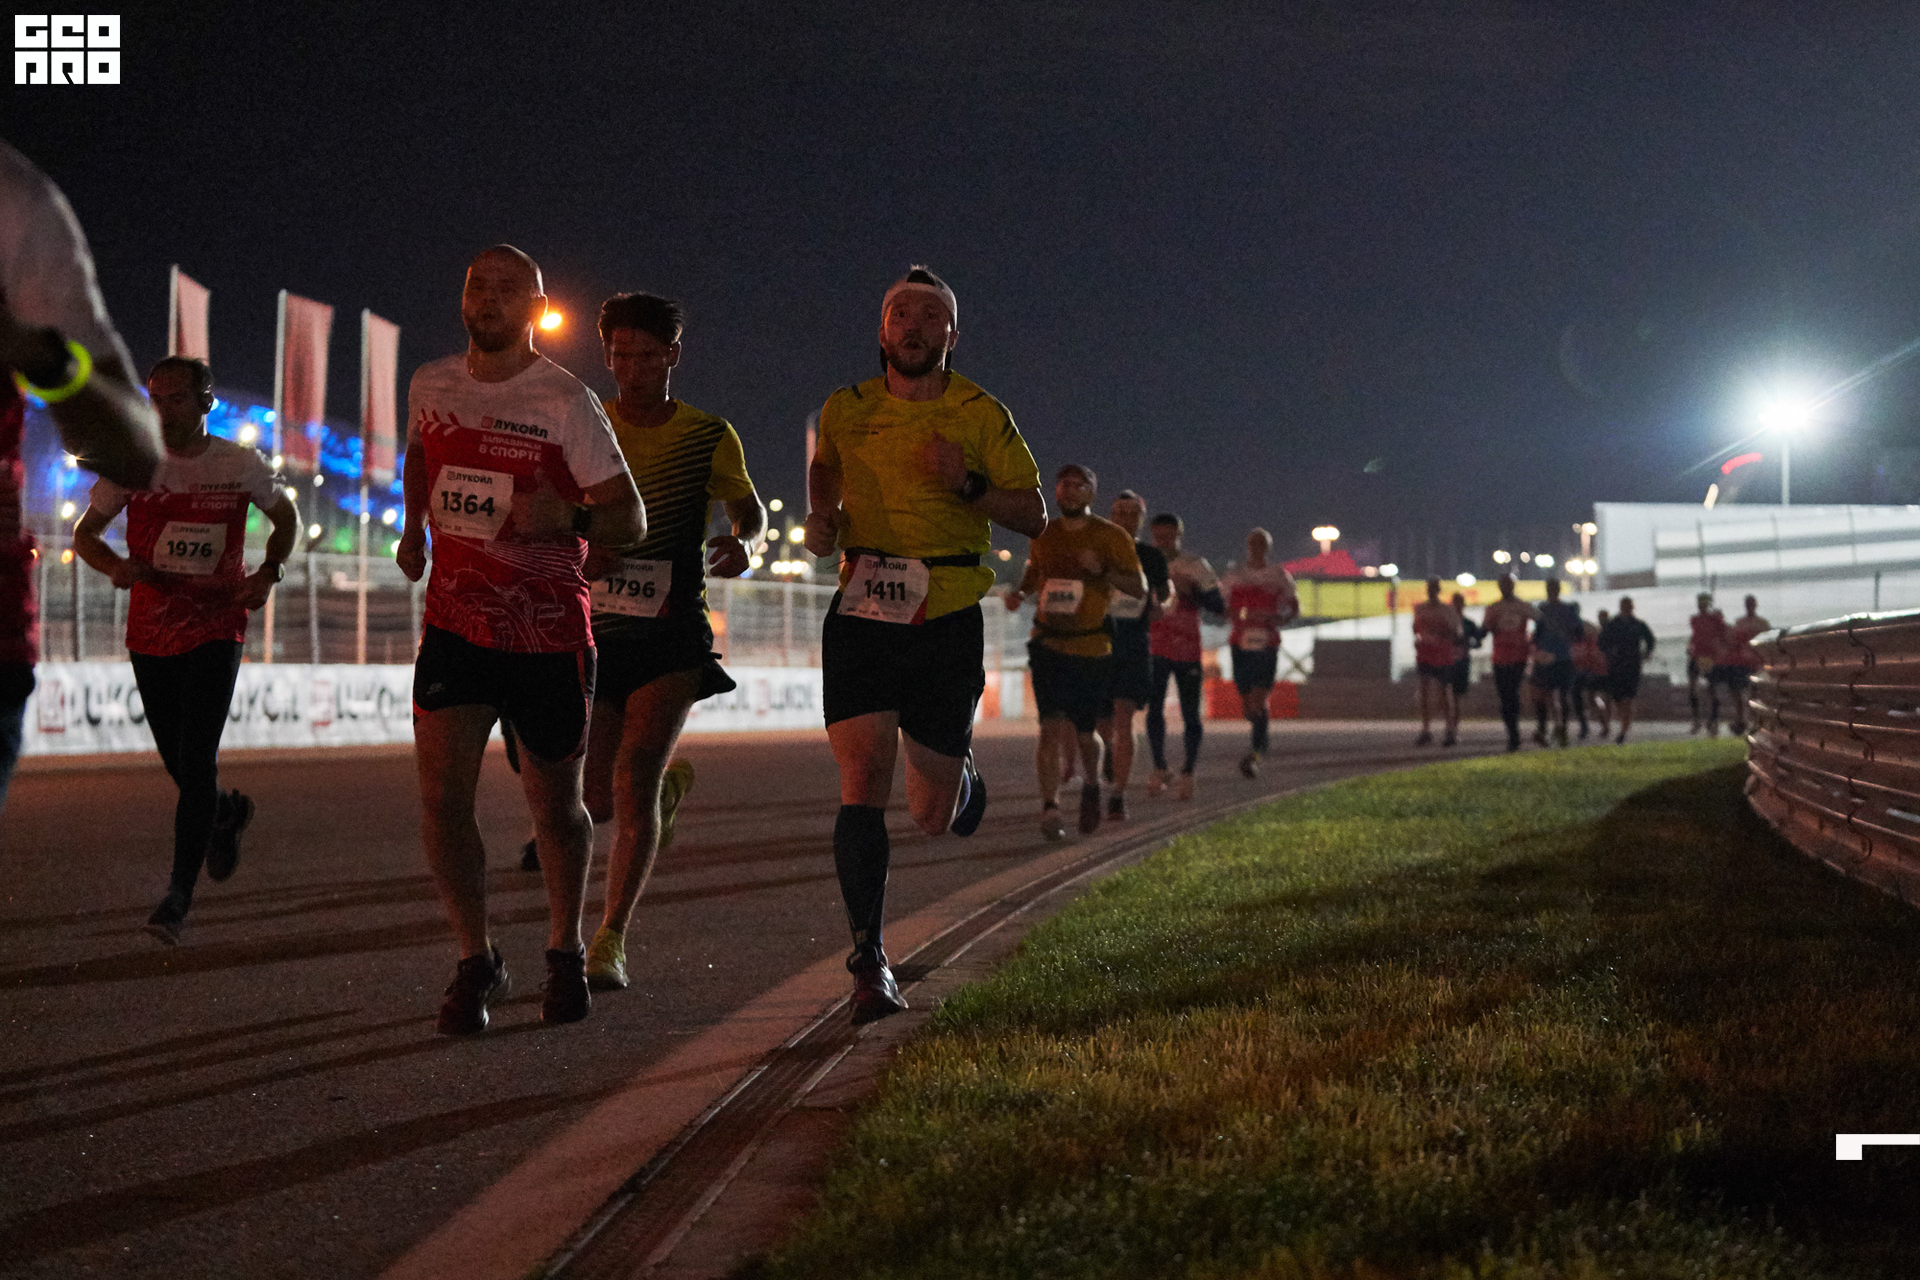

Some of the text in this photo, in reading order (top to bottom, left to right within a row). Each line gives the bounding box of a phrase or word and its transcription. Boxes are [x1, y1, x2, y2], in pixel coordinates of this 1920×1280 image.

[494, 419, 548, 438] ЛУКОЙЛ
[479, 444, 542, 462] В СПОРТЕ
[455, 472, 493, 484] ЛУКОЙЛ
[441, 490, 495, 517] 1364
[167, 540, 213, 558] 1976
[625, 563, 654, 571] УКОЙЛ
[605, 577, 656, 598] 1796
[864, 579, 906, 601] 1411
